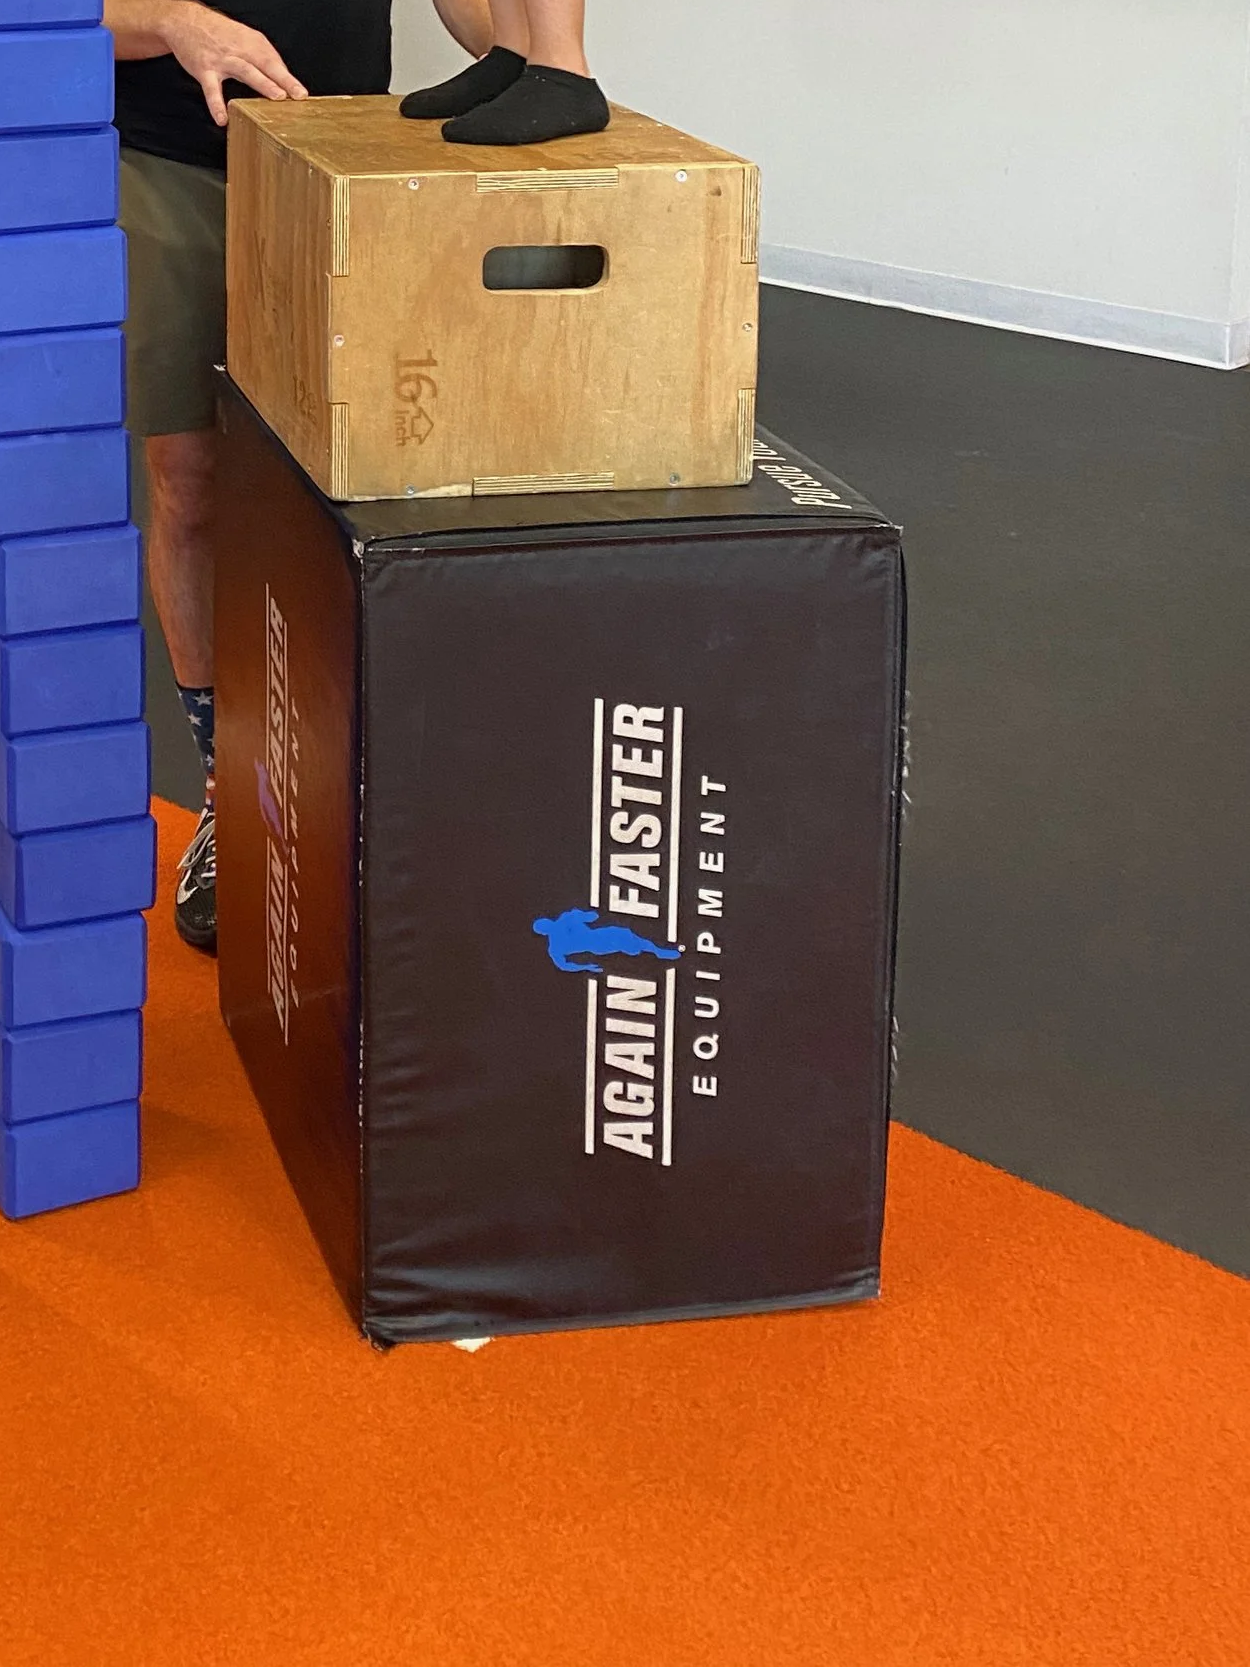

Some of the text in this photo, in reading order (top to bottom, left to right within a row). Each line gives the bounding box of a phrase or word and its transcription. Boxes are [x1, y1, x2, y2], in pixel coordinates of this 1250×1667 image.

[394, 349, 438, 403] 16
[758, 464, 852, 510] Pursue
[270, 597, 285, 1033] AGAIN FASTER
[290, 697, 299, 1008] EQUIPMENT
[602, 702, 665, 1160] AGAIN FASTER
[692, 775, 727, 1097] EQUIPMENT
